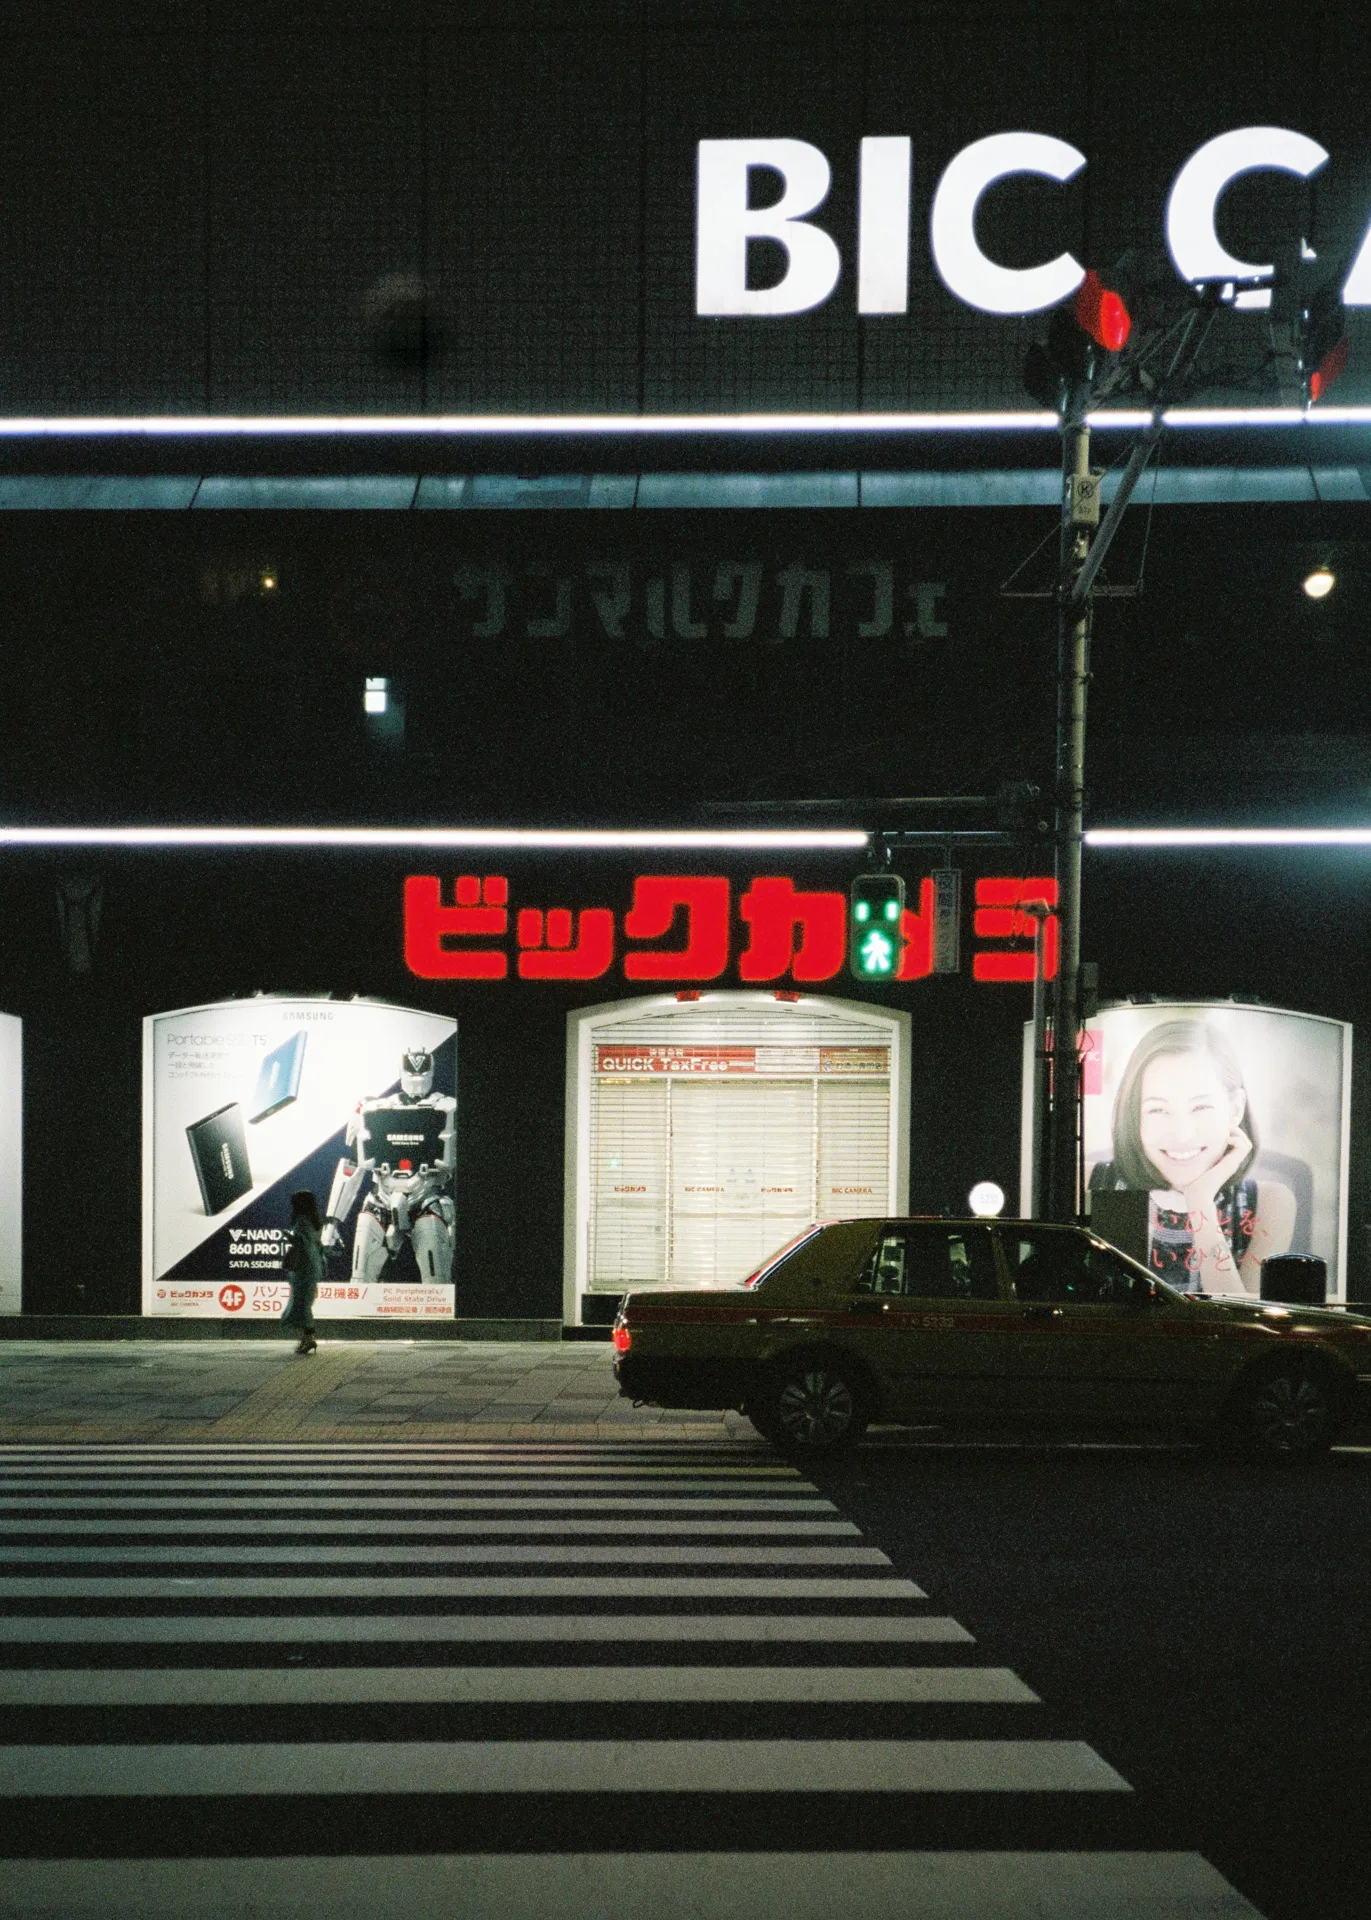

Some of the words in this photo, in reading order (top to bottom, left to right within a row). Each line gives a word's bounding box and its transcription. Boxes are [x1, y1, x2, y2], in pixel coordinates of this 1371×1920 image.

[695, 131, 1087, 316] BIC
[1166, 126, 1371, 310] C
[452, 559, 949, 640] サンマルクカフェ
[282, 1011, 334, 1021] SAMSUNG
[167, 1033, 225, 1046] Portable
[251, 1034, 268, 1047] T5
[602, 1057, 654, 1071] QUICK
[660, 1057, 728, 1071] TaxFree
[386, 1133, 425, 1142] SAMSUNG
[229, 1243, 252, 1255] 860
[253, 1243, 279, 1255] PRO
[229, 1260, 250, 1269] SATA
[170, 1290, 214, 1299] ビックカメラ
[383, 1287, 393, 1295] PC
[221, 1289, 243, 1307] 4F
[252, 1300, 282, 1312] SSD
